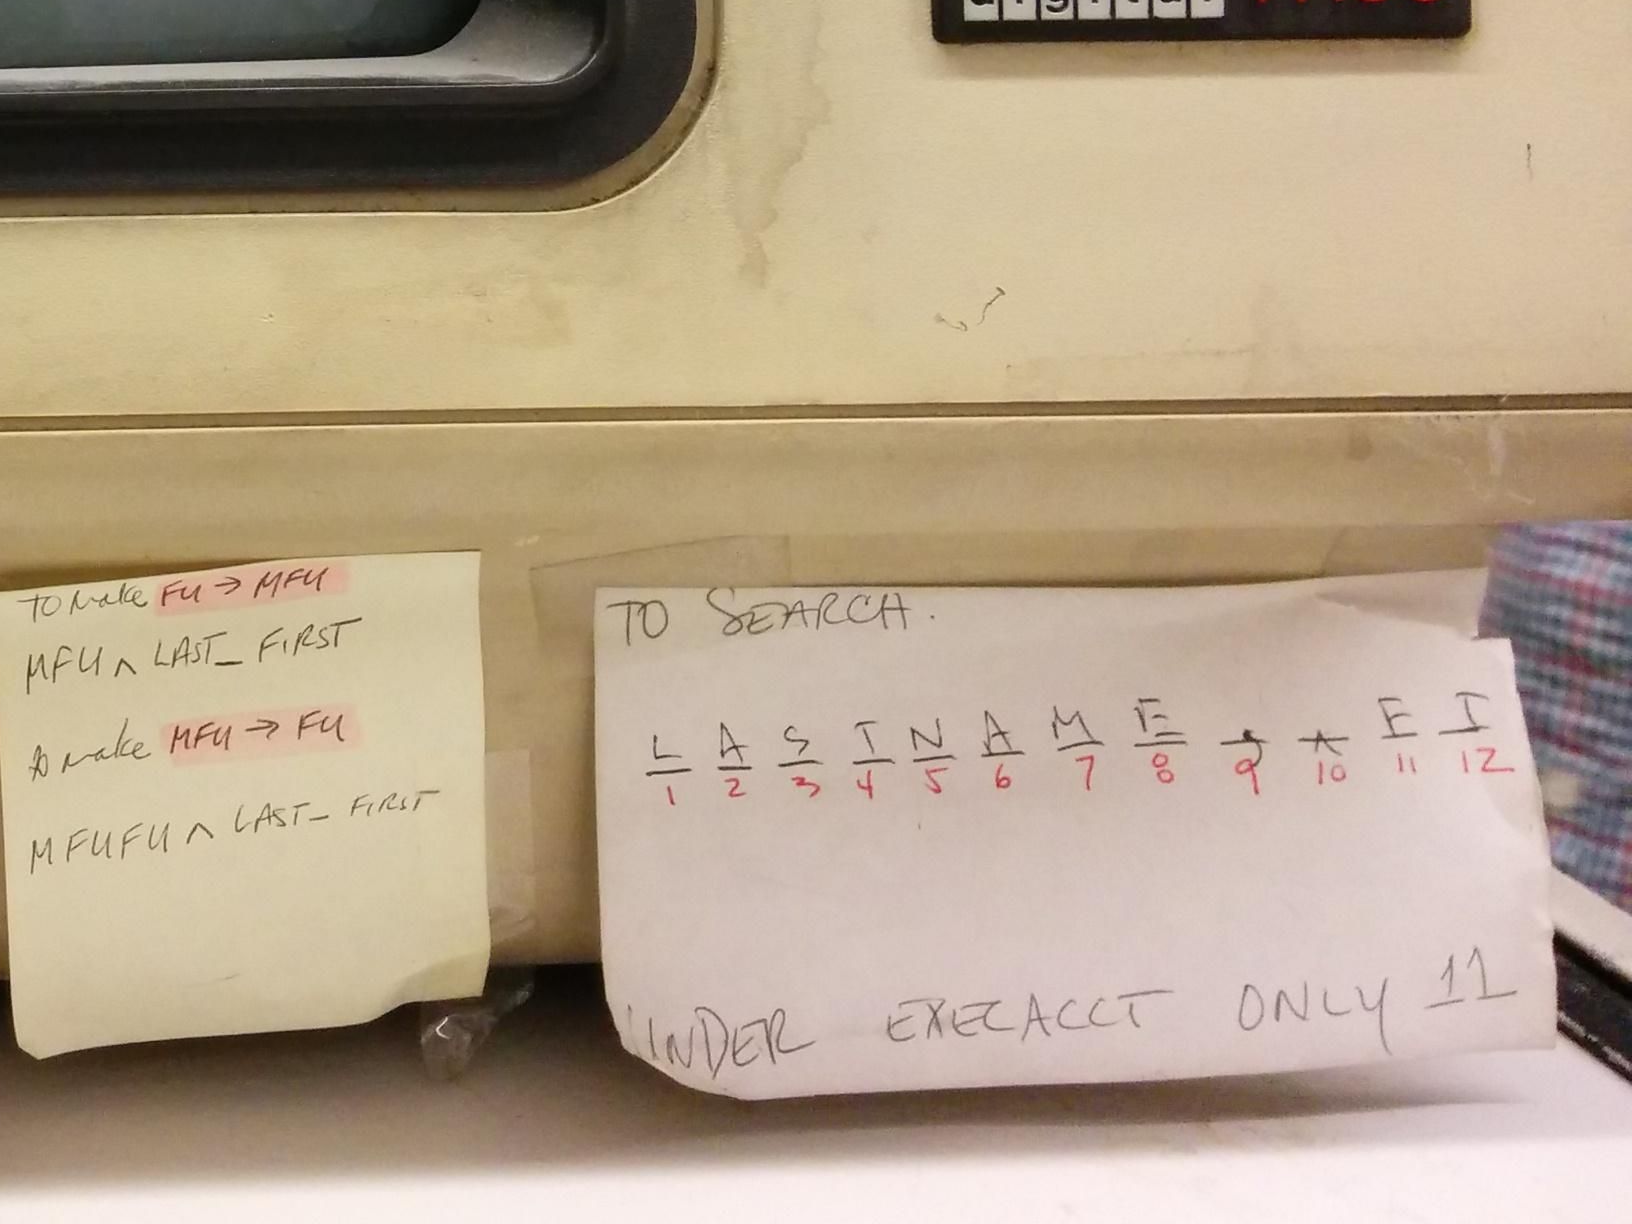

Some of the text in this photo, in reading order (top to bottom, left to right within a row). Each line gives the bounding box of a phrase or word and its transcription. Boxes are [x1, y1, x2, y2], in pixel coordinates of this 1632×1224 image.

[607, 599, 668, 646] TO
[884, 988, 1175, 1043] EXECACCT
[1236, 976, 1390, 1055] ONLY
